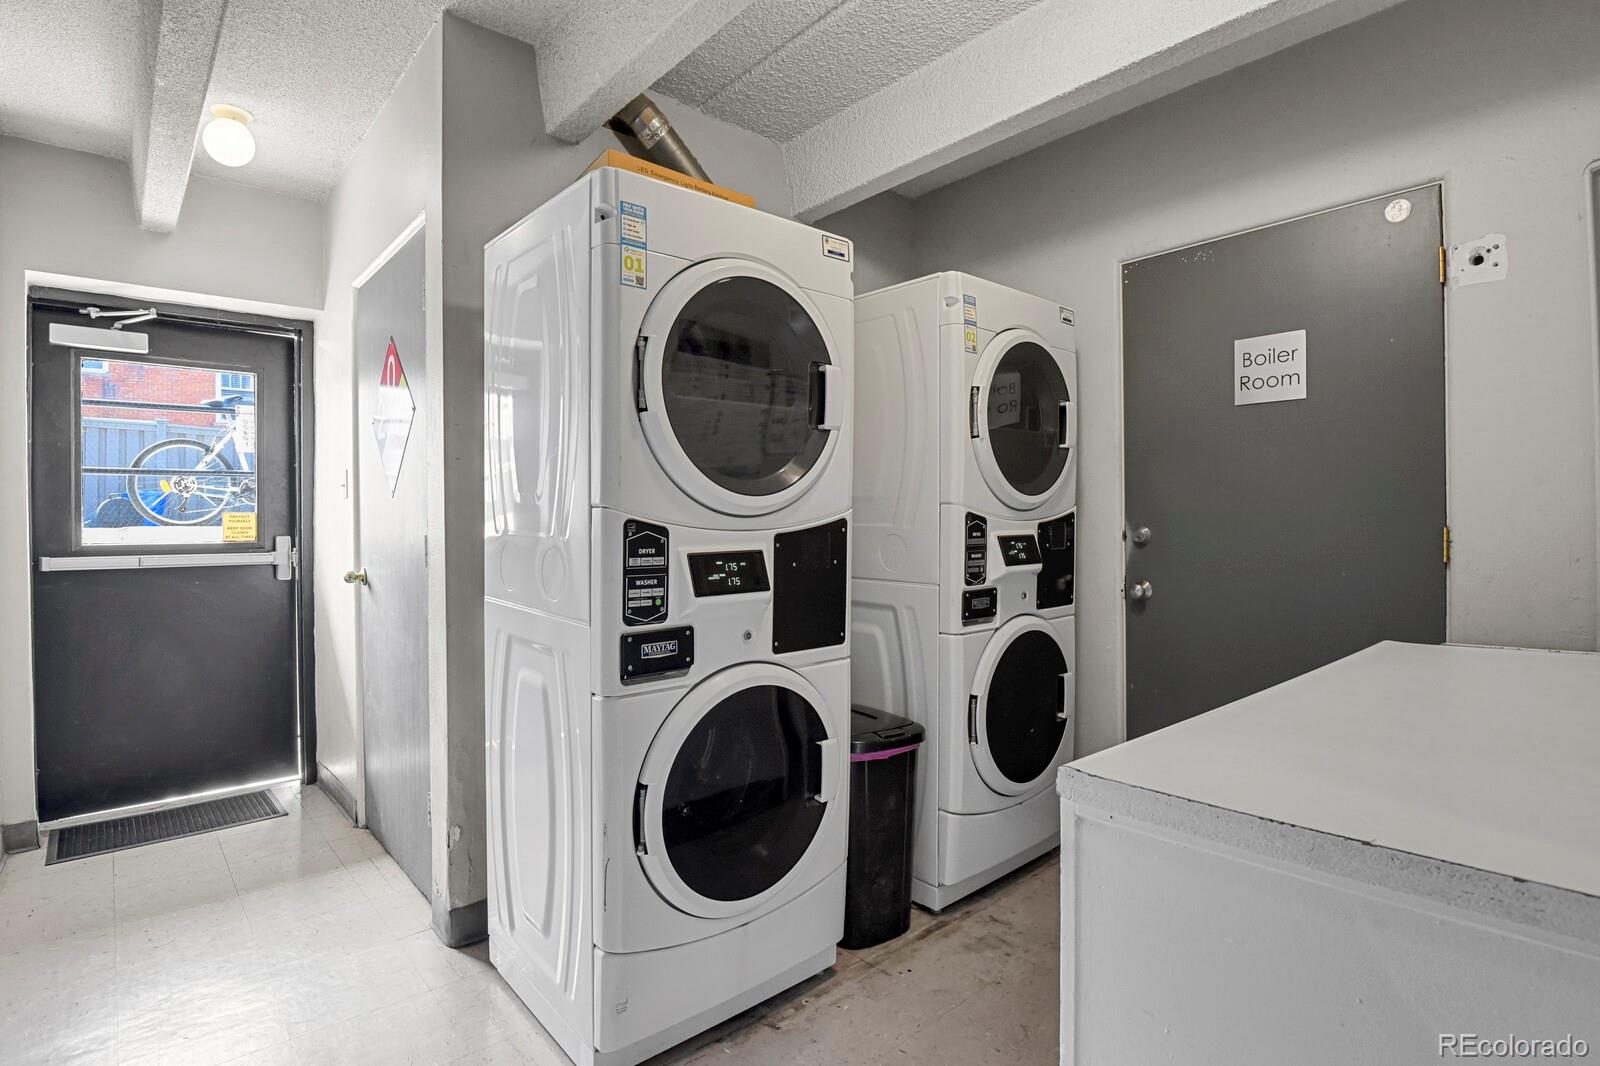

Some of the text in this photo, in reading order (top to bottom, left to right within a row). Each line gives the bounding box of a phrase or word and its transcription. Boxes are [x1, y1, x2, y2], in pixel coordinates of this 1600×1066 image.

[651, 171, 679, 186] Emergency
[623, 255, 644, 274] 01
[1242, 347, 1299, 368] Boiler
[1240, 372, 1301, 391] Room
[643, 643, 676, 654] MAYTAG
